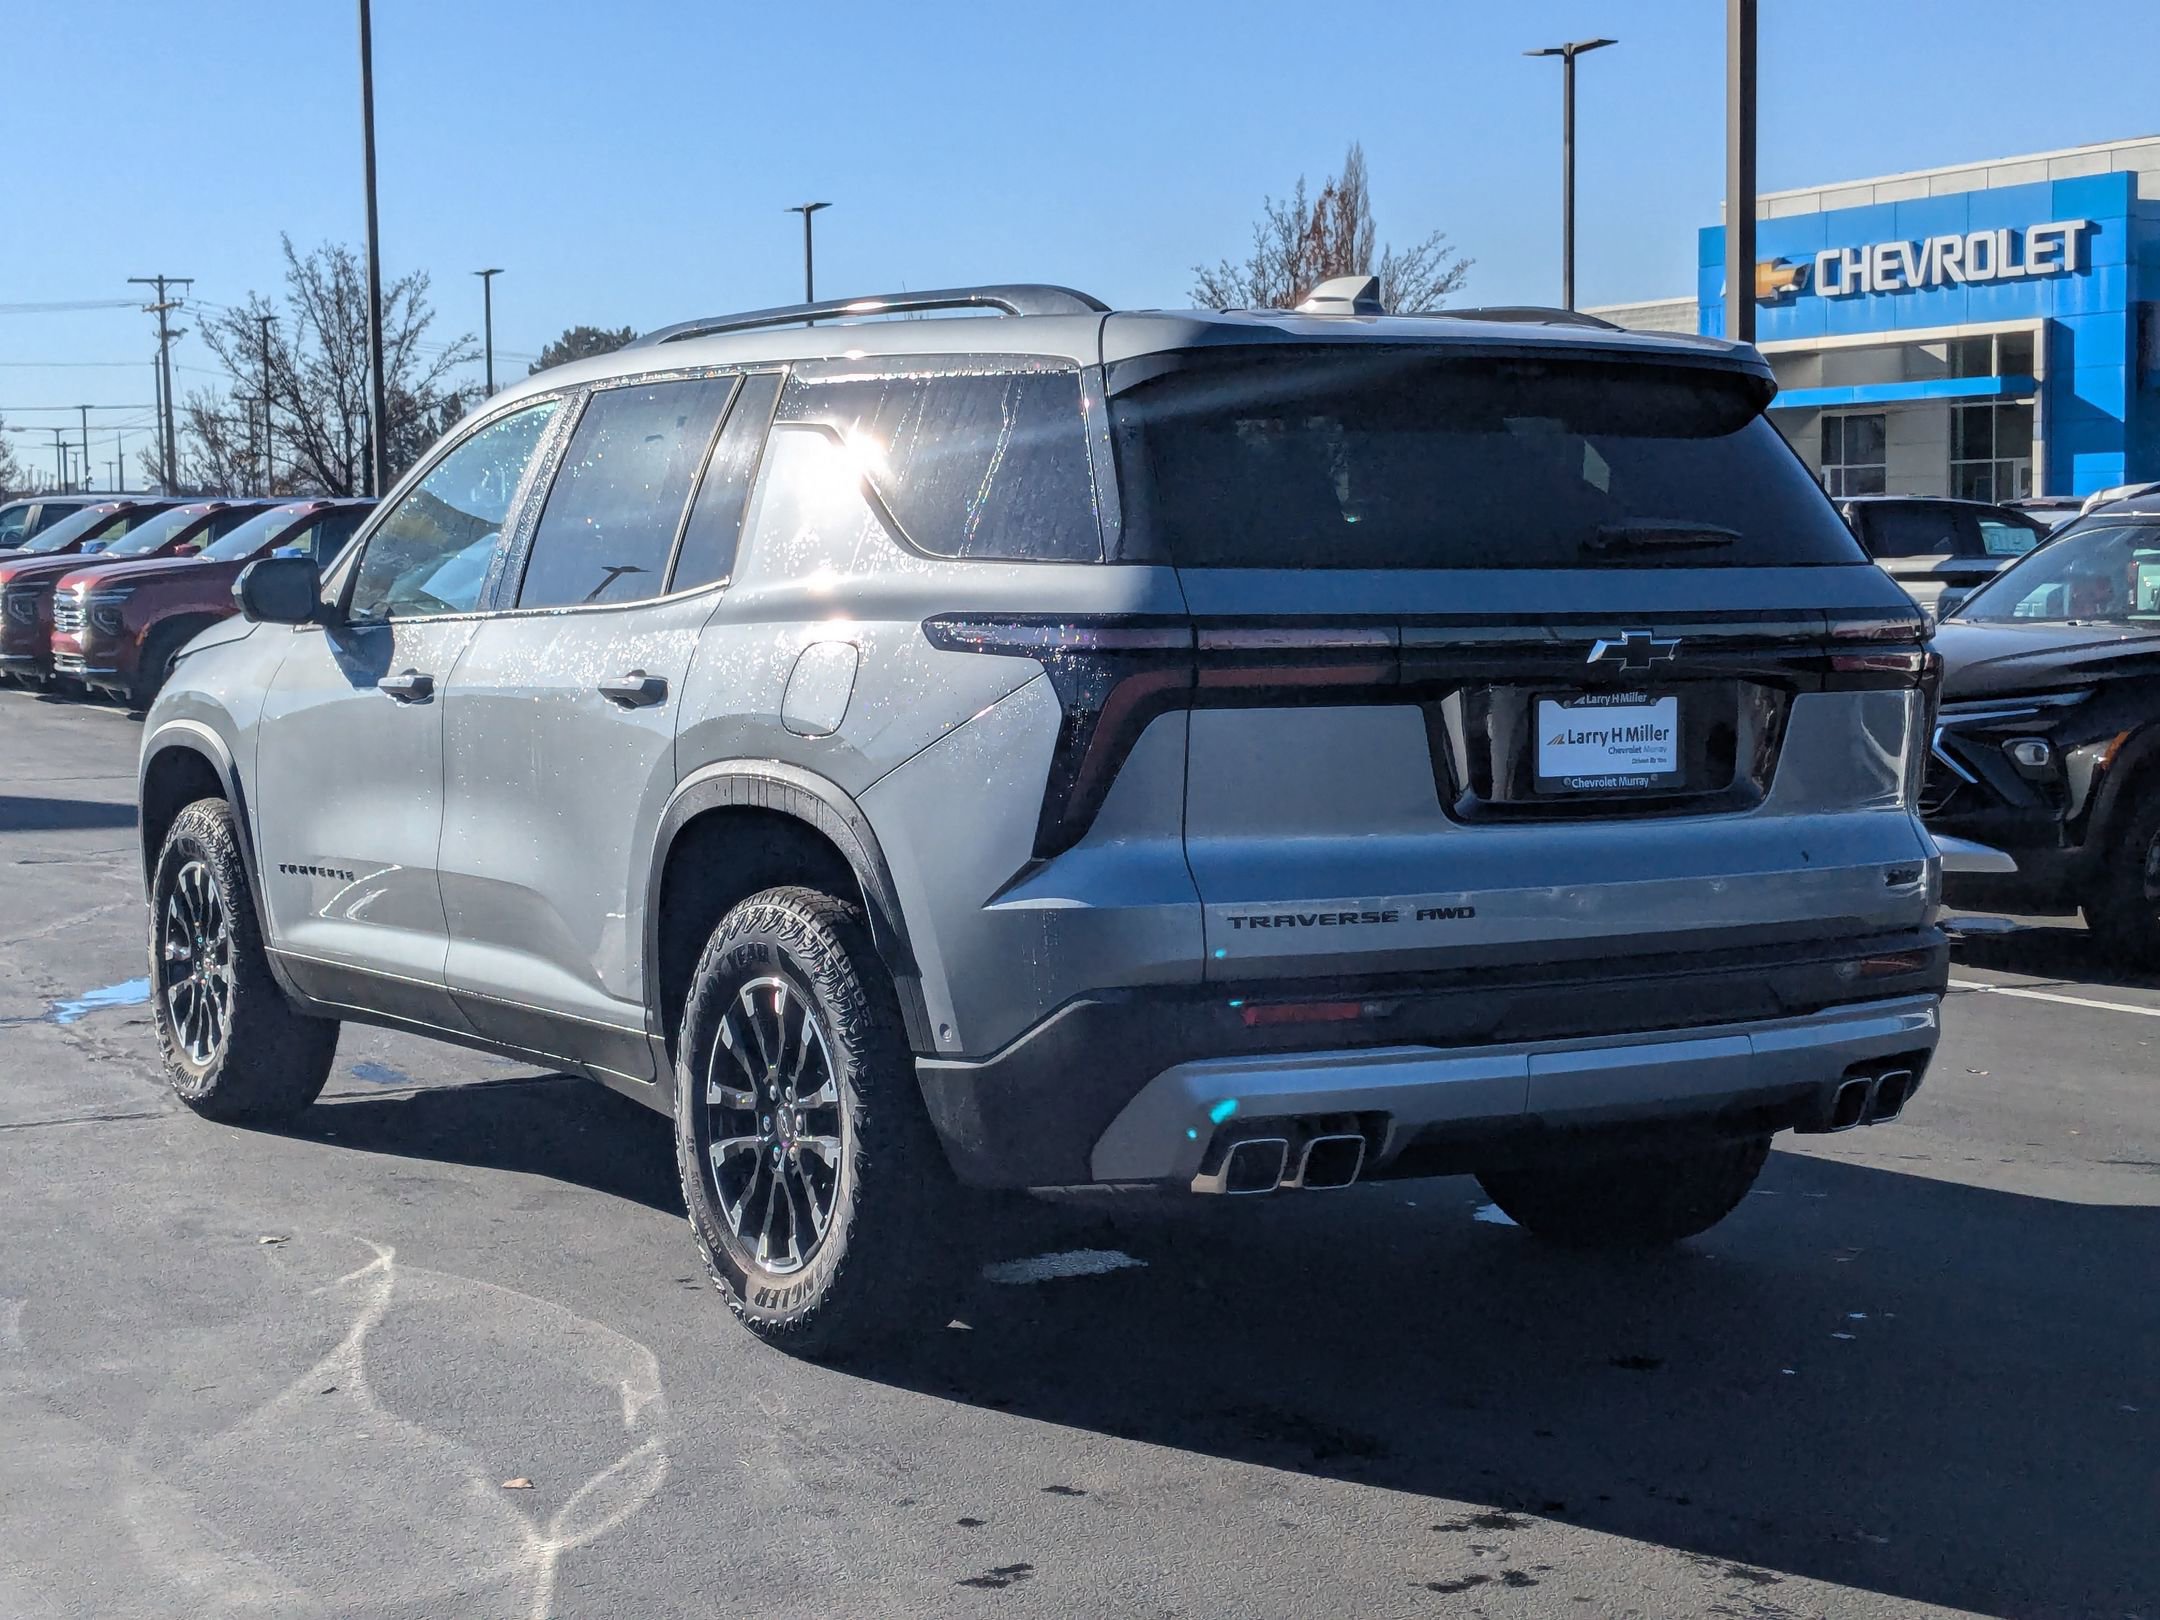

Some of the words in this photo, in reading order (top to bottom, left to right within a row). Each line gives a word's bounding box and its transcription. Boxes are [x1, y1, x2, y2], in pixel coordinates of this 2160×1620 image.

[1814, 219, 2087, 297] CHEVROLET
[1586, 694, 1610, 706] Larry
[1612, 693, 1620, 704] H
[1620, 691, 1647, 703] Miller
[1568, 729, 1608, 747] Larry
[1612, 727, 1622, 743] H
[1626, 724, 1669, 742] Miller
[1608, 745, 1642, 755] Chevrolet
[1572, 776, 1617, 788] Chevrolet
[1618, 776, 1649, 788] Murray
[1227, 910, 1399, 929] TRAVERSE
[1416, 906, 1476, 921] AWD
